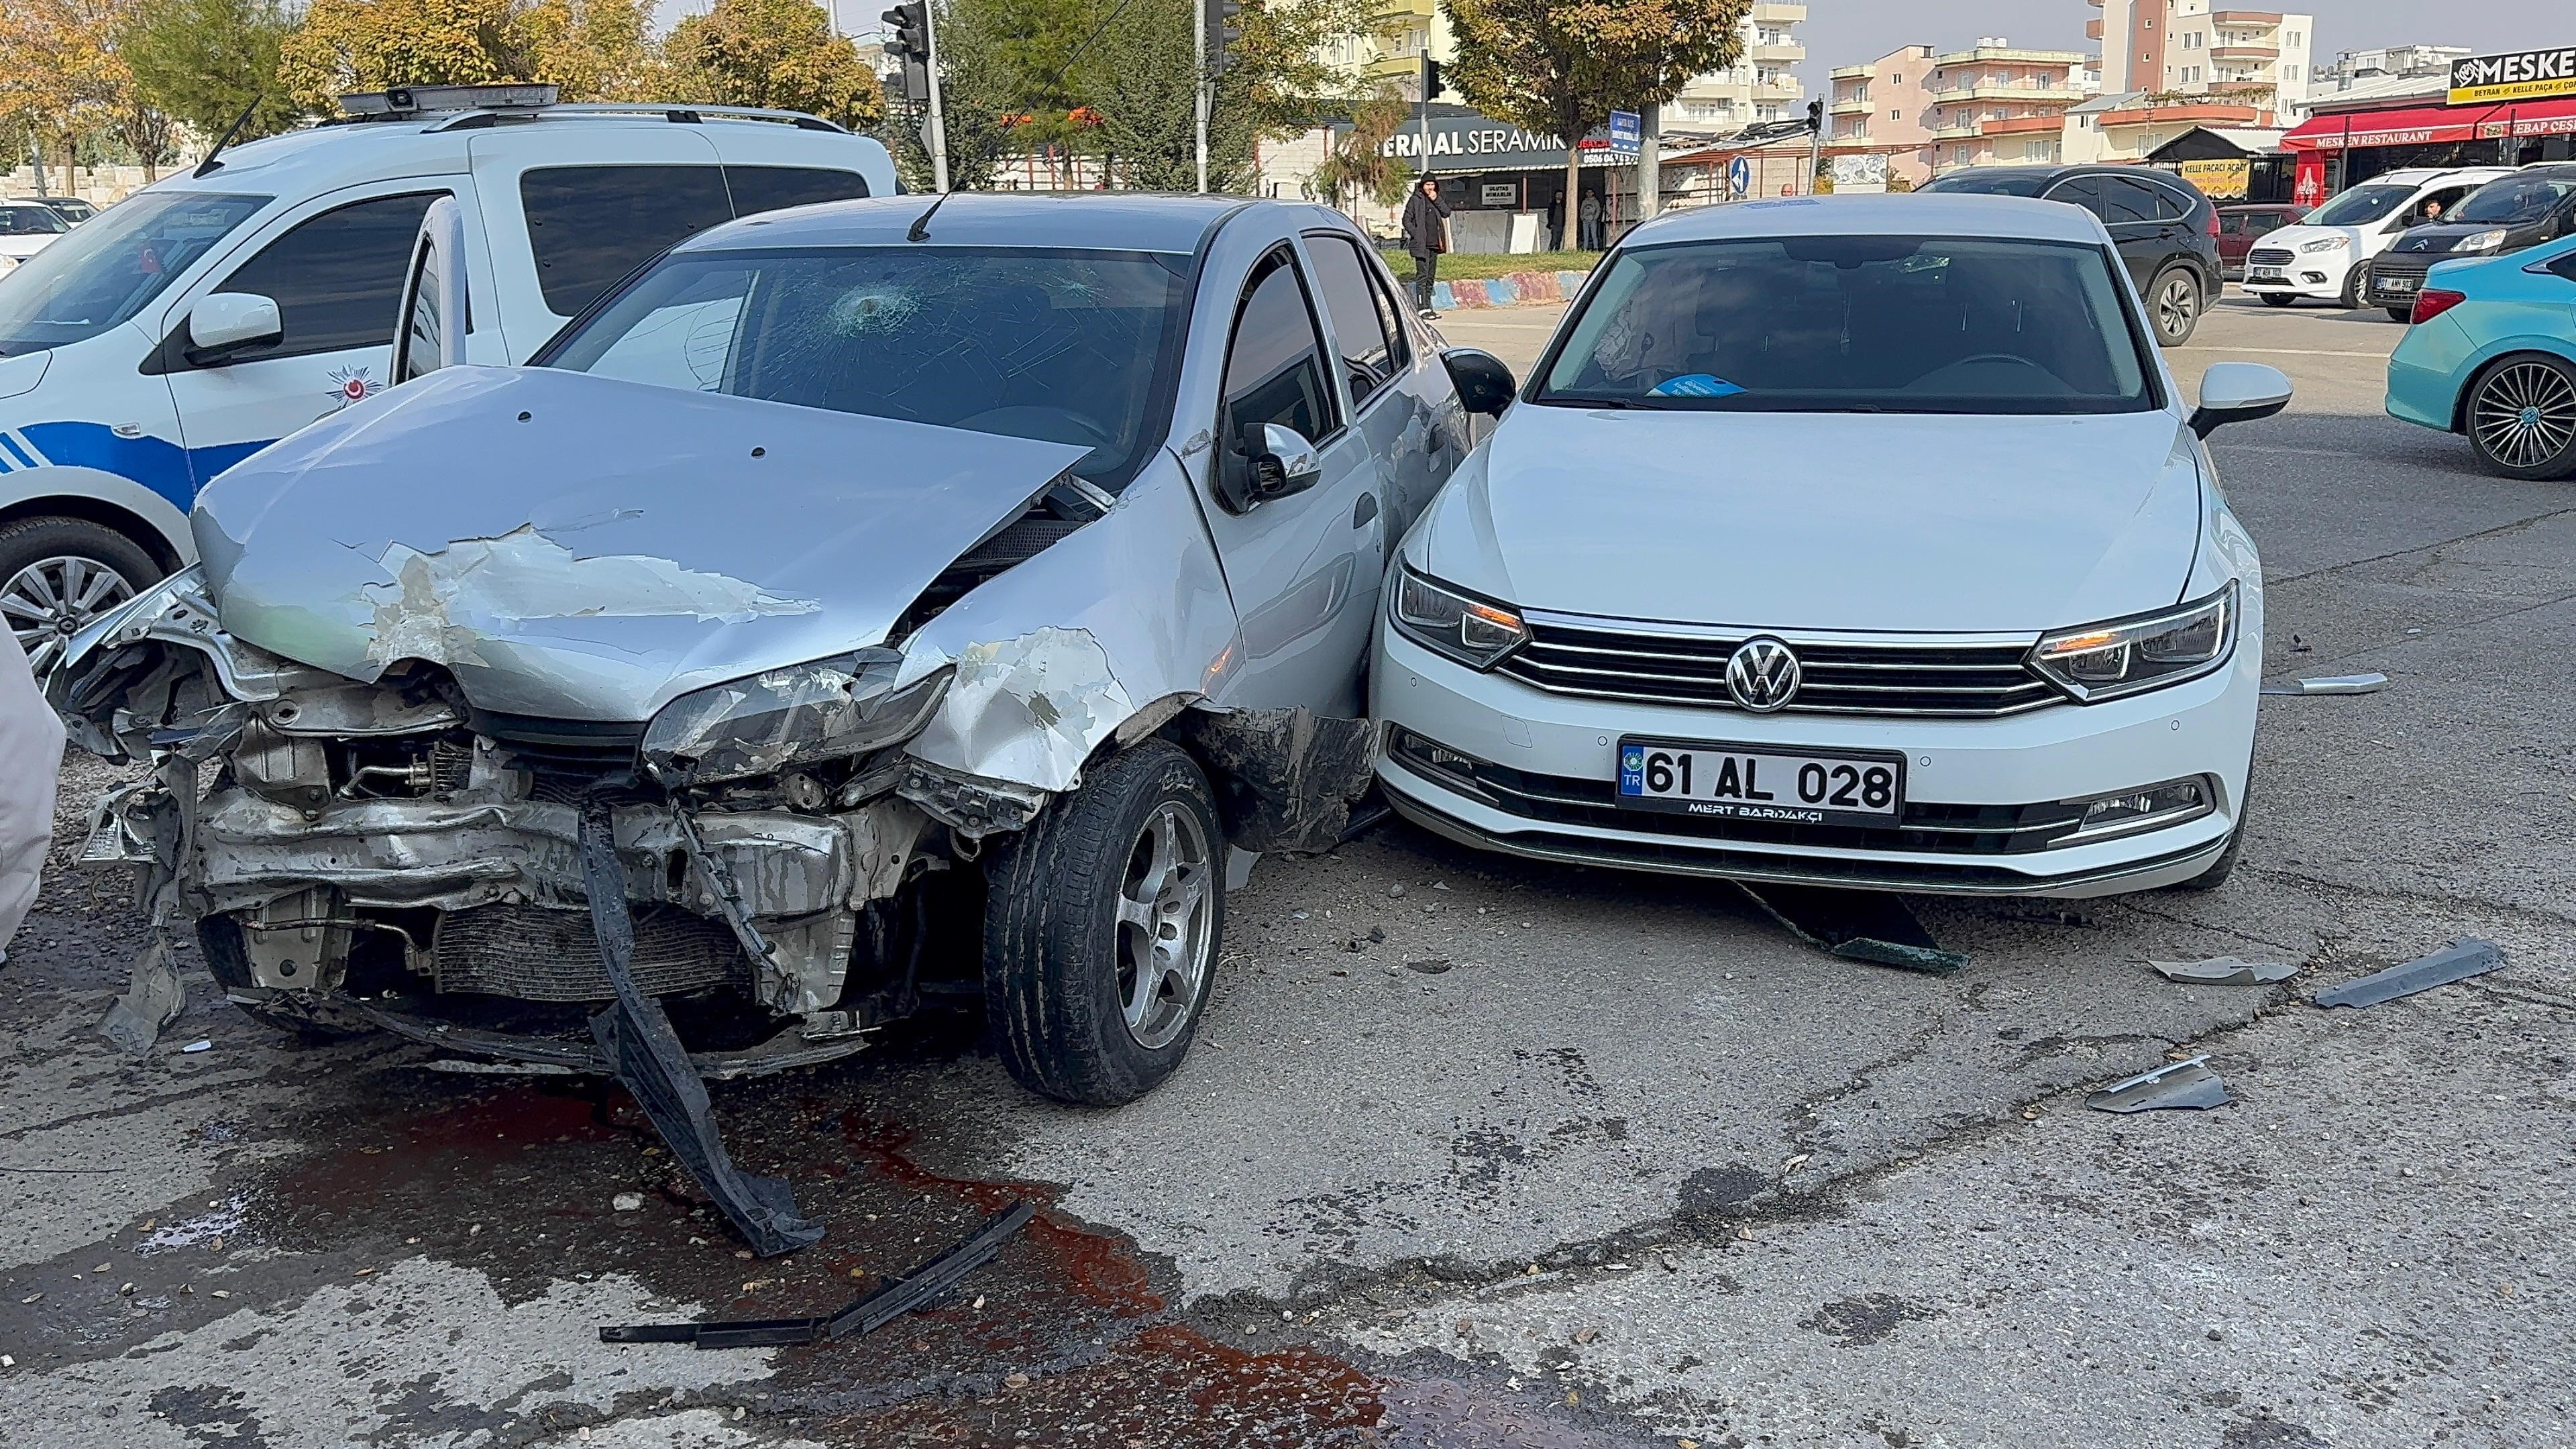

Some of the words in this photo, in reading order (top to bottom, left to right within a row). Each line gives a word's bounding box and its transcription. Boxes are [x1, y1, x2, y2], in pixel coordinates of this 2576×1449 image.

[2477, 50, 2576, 84] MESKE
[2474, 88, 2500, 97] BEYRAN
[2513, 85, 2533, 93] KELLE
[2535, 84, 2553, 93] PAÇA
[1375, 131, 1463, 157] ERMAL
[2361, 131, 2432, 145] RESTAURANT
[1584, 154, 1603, 163] 0506
[2185, 164, 2202, 173] KELLE
[1623, 774, 1640, 786] TR
[1646, 751, 1692, 795] 61
[1714, 757, 1774, 801] AL
[1798, 762, 1893, 808] 028
[1688, 803, 1734, 815] MERT
